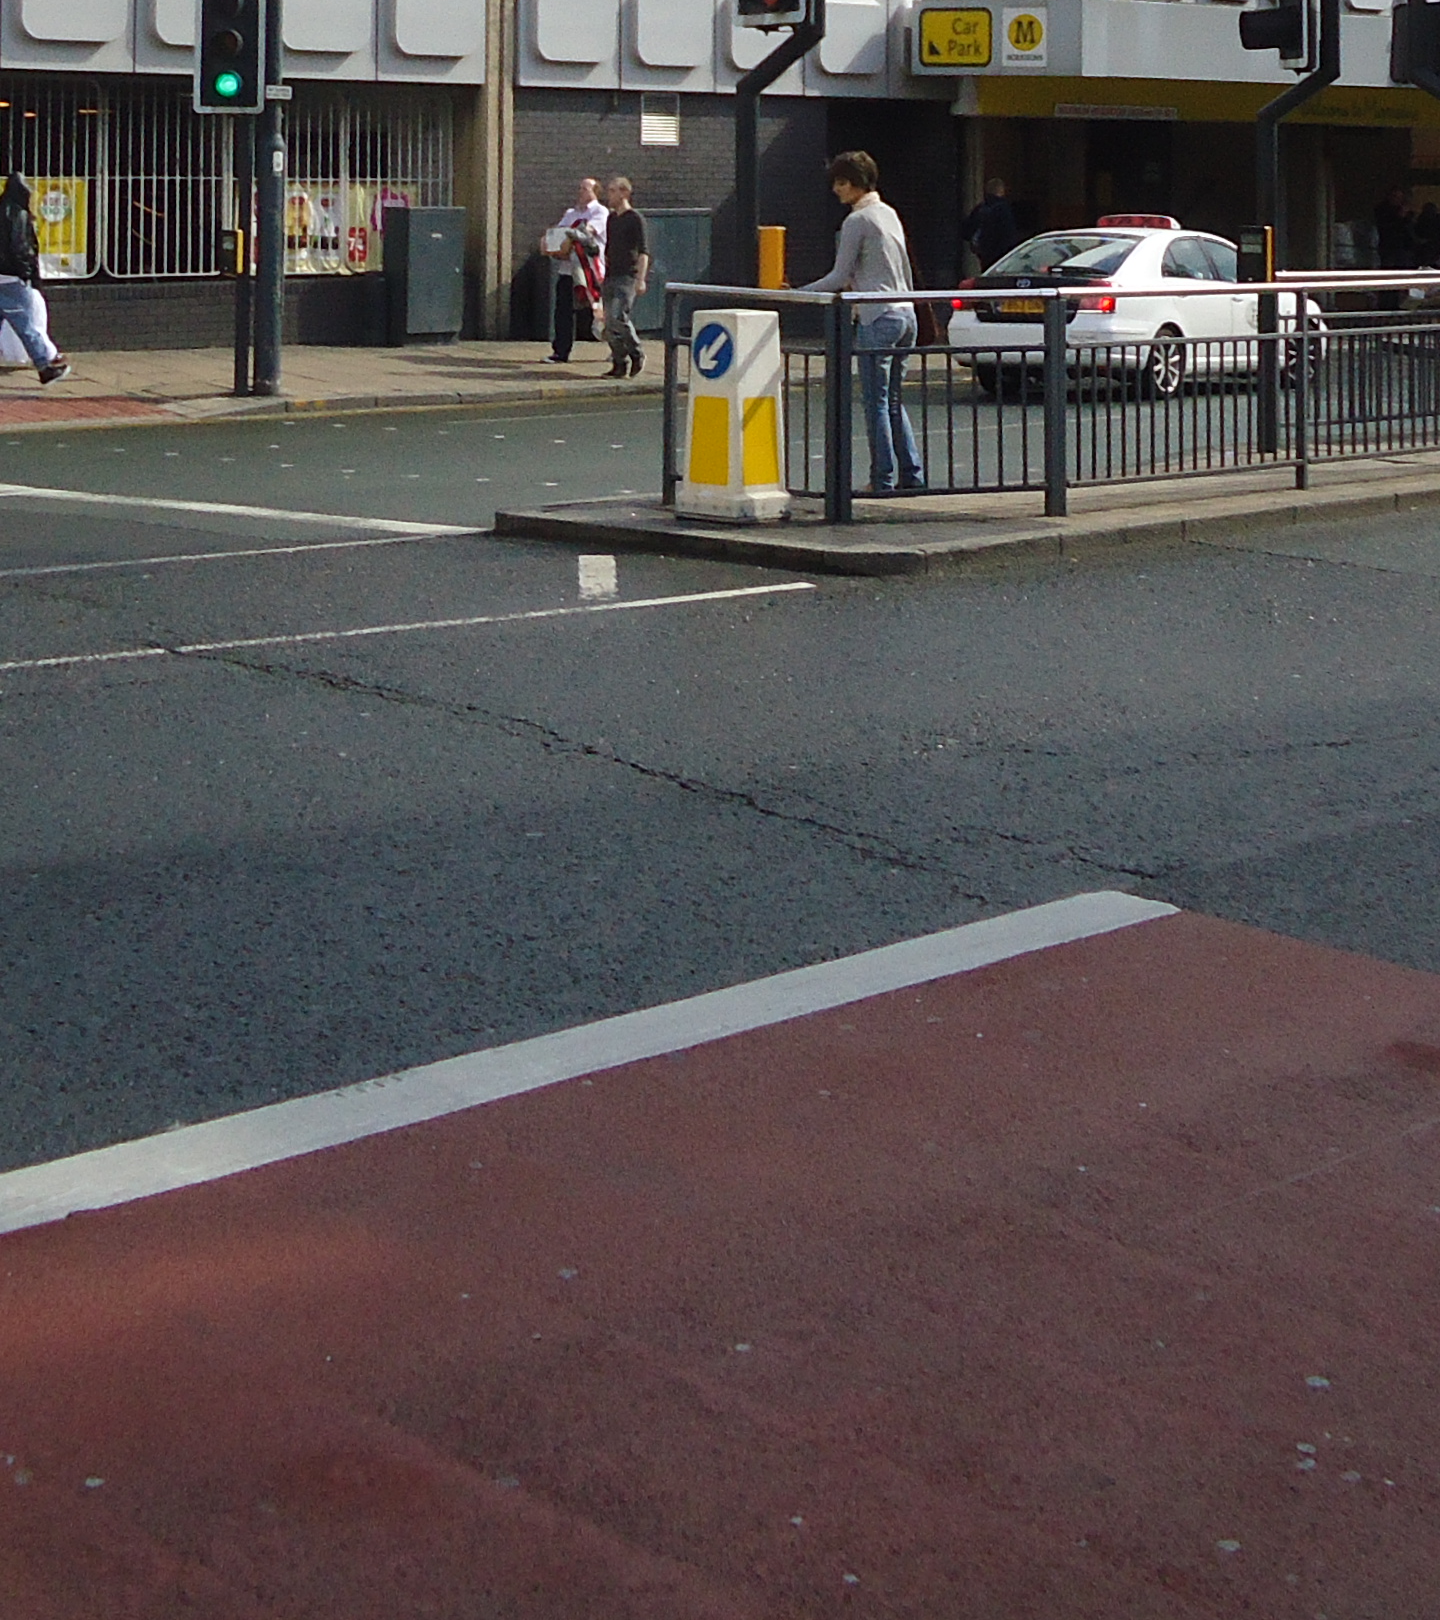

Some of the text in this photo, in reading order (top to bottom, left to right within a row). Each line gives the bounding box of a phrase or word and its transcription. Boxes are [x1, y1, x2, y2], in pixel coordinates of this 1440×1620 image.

[951, 17, 979, 36] Car
[1013, 20, 1036, 44] M
[947, 39, 983, 56] Park
